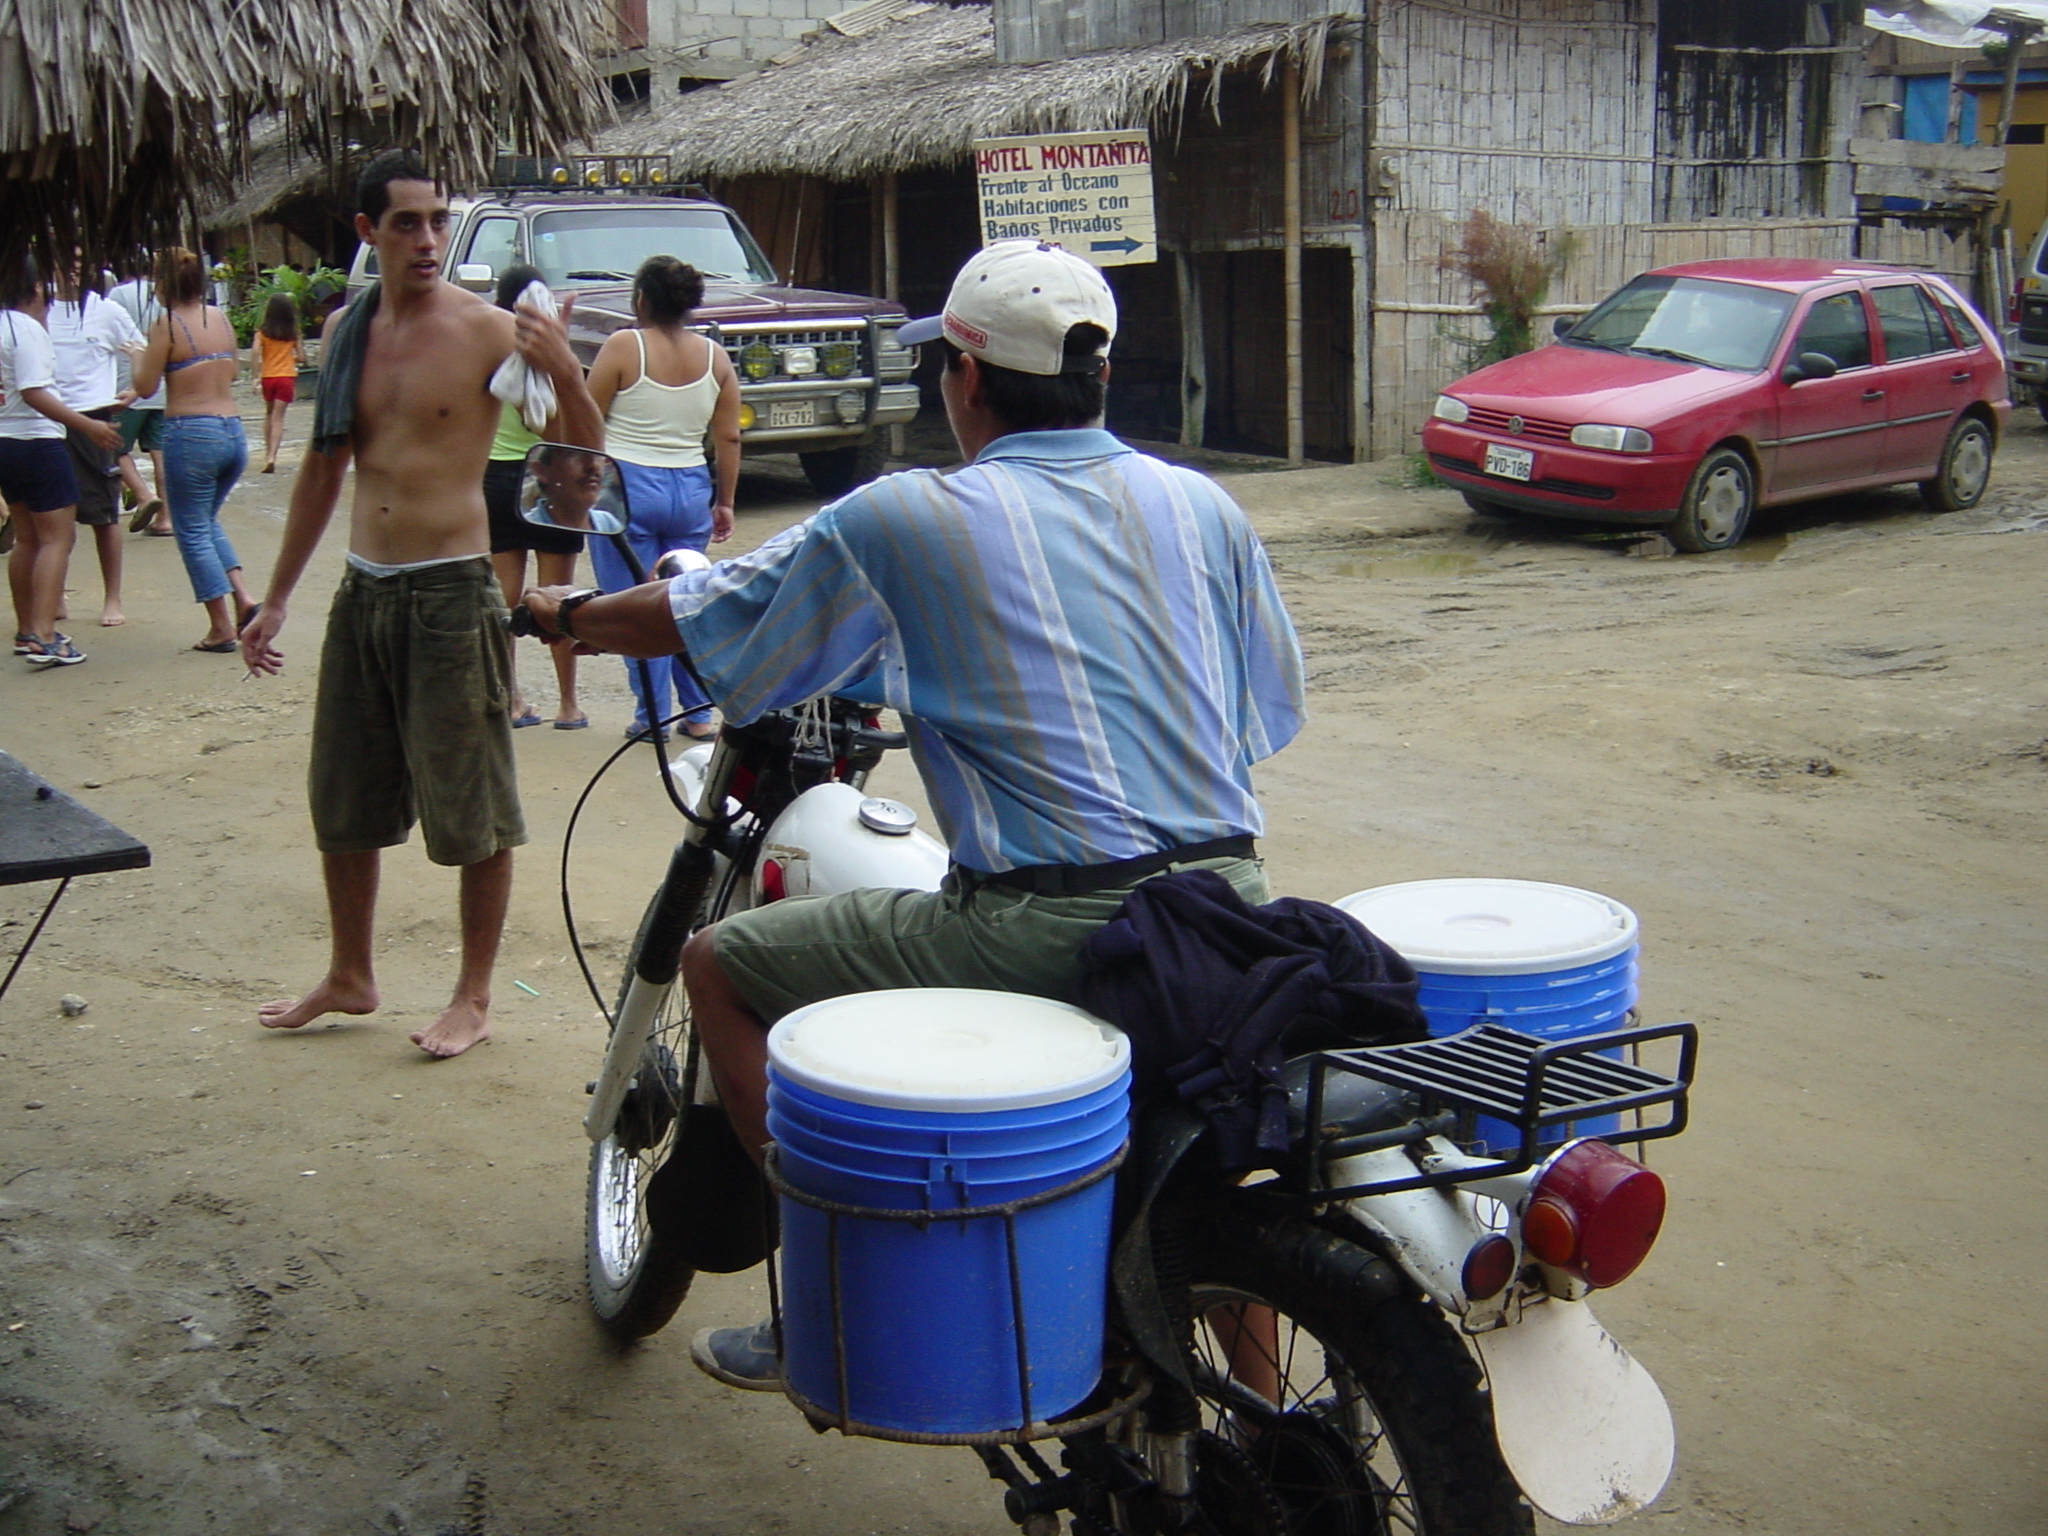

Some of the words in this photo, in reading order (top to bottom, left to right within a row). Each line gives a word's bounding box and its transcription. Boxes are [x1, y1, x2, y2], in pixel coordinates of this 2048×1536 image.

[975, 147, 1033, 174] HOTEL
[1040, 139, 1151, 170] MONTAÑITA
[980, 178, 1028, 197] Frente
[1038, 175, 1053, 192] al
[1062, 172, 1119, 191] Oceano
[984, 197, 1088, 217] Habitaciones
[1098, 195, 1130, 211] con
[986, 219, 1041, 240] Baños
[1048, 214, 1123, 236] Privados
[1485, 455, 1530, 478] PVD-186
